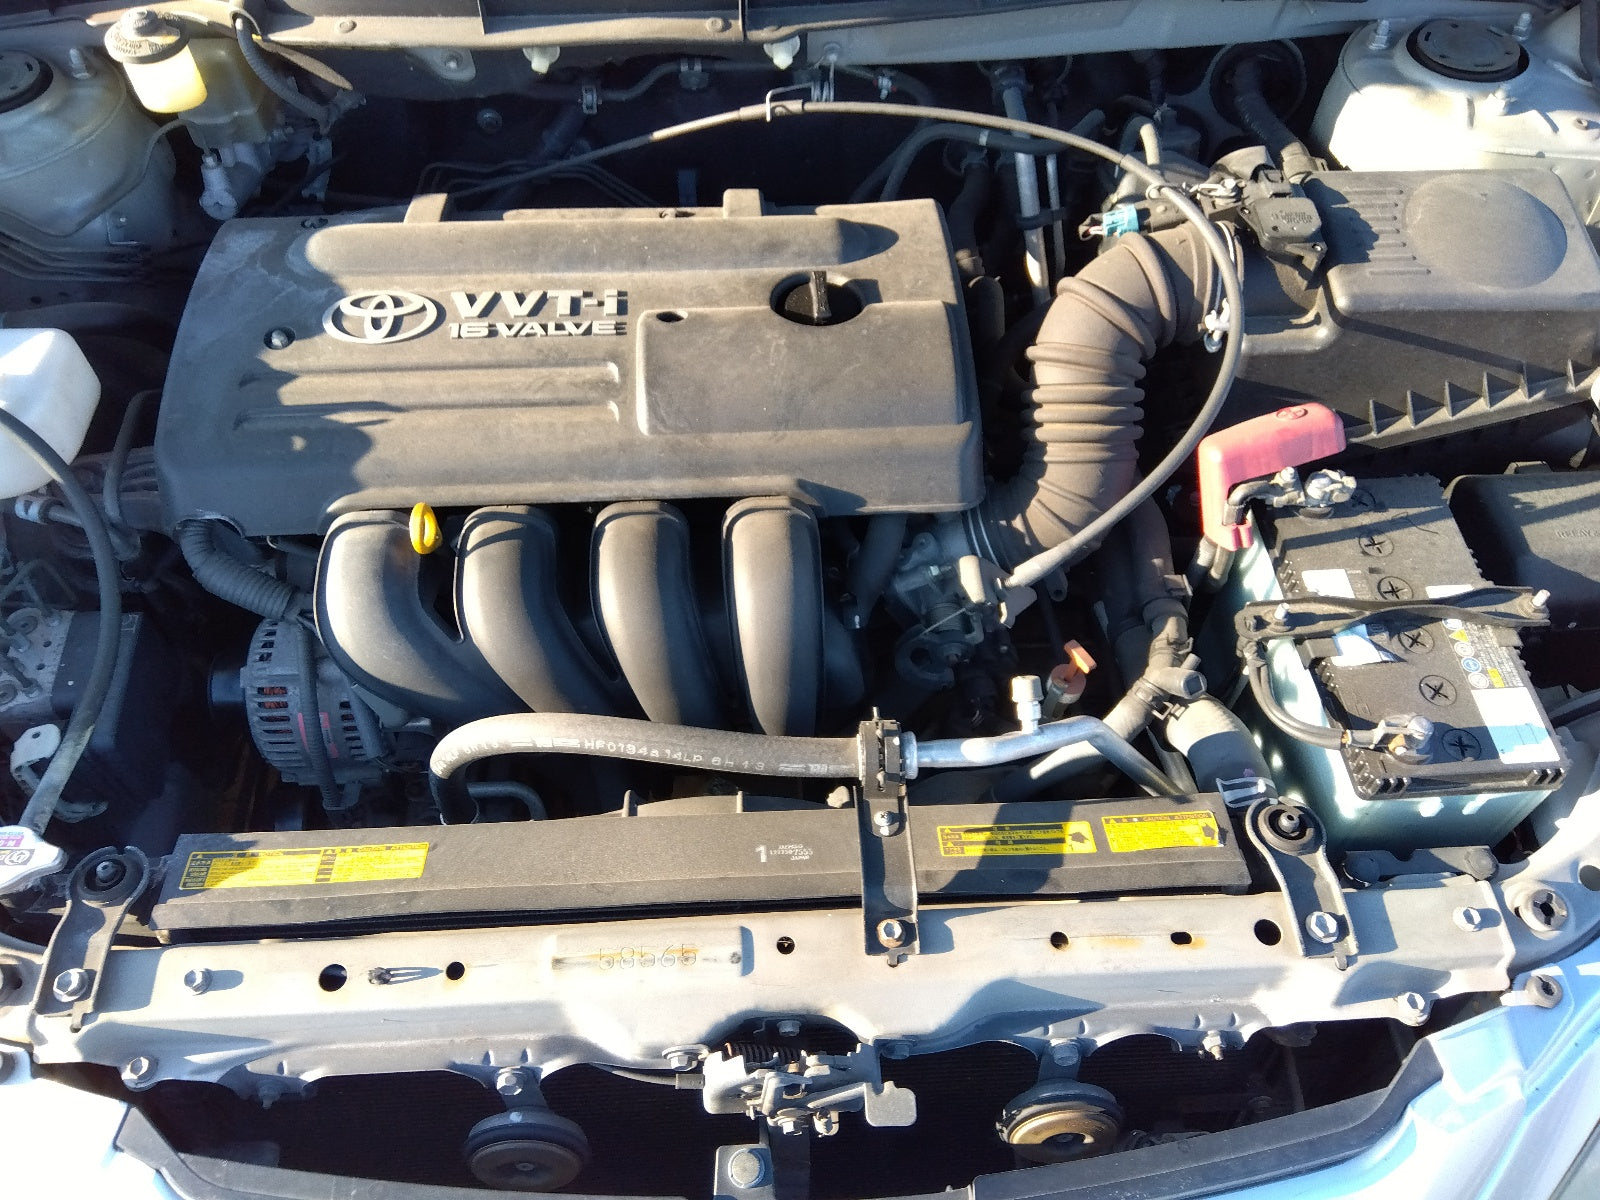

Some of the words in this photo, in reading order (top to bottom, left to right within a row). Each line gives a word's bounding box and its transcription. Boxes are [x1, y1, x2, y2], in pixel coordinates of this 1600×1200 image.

[449, 321, 489, 339] 16
[495, 320, 618, 338] VALVE
[755, 844, 767, 862] 1
[598, 943, 698, 970] 58565
